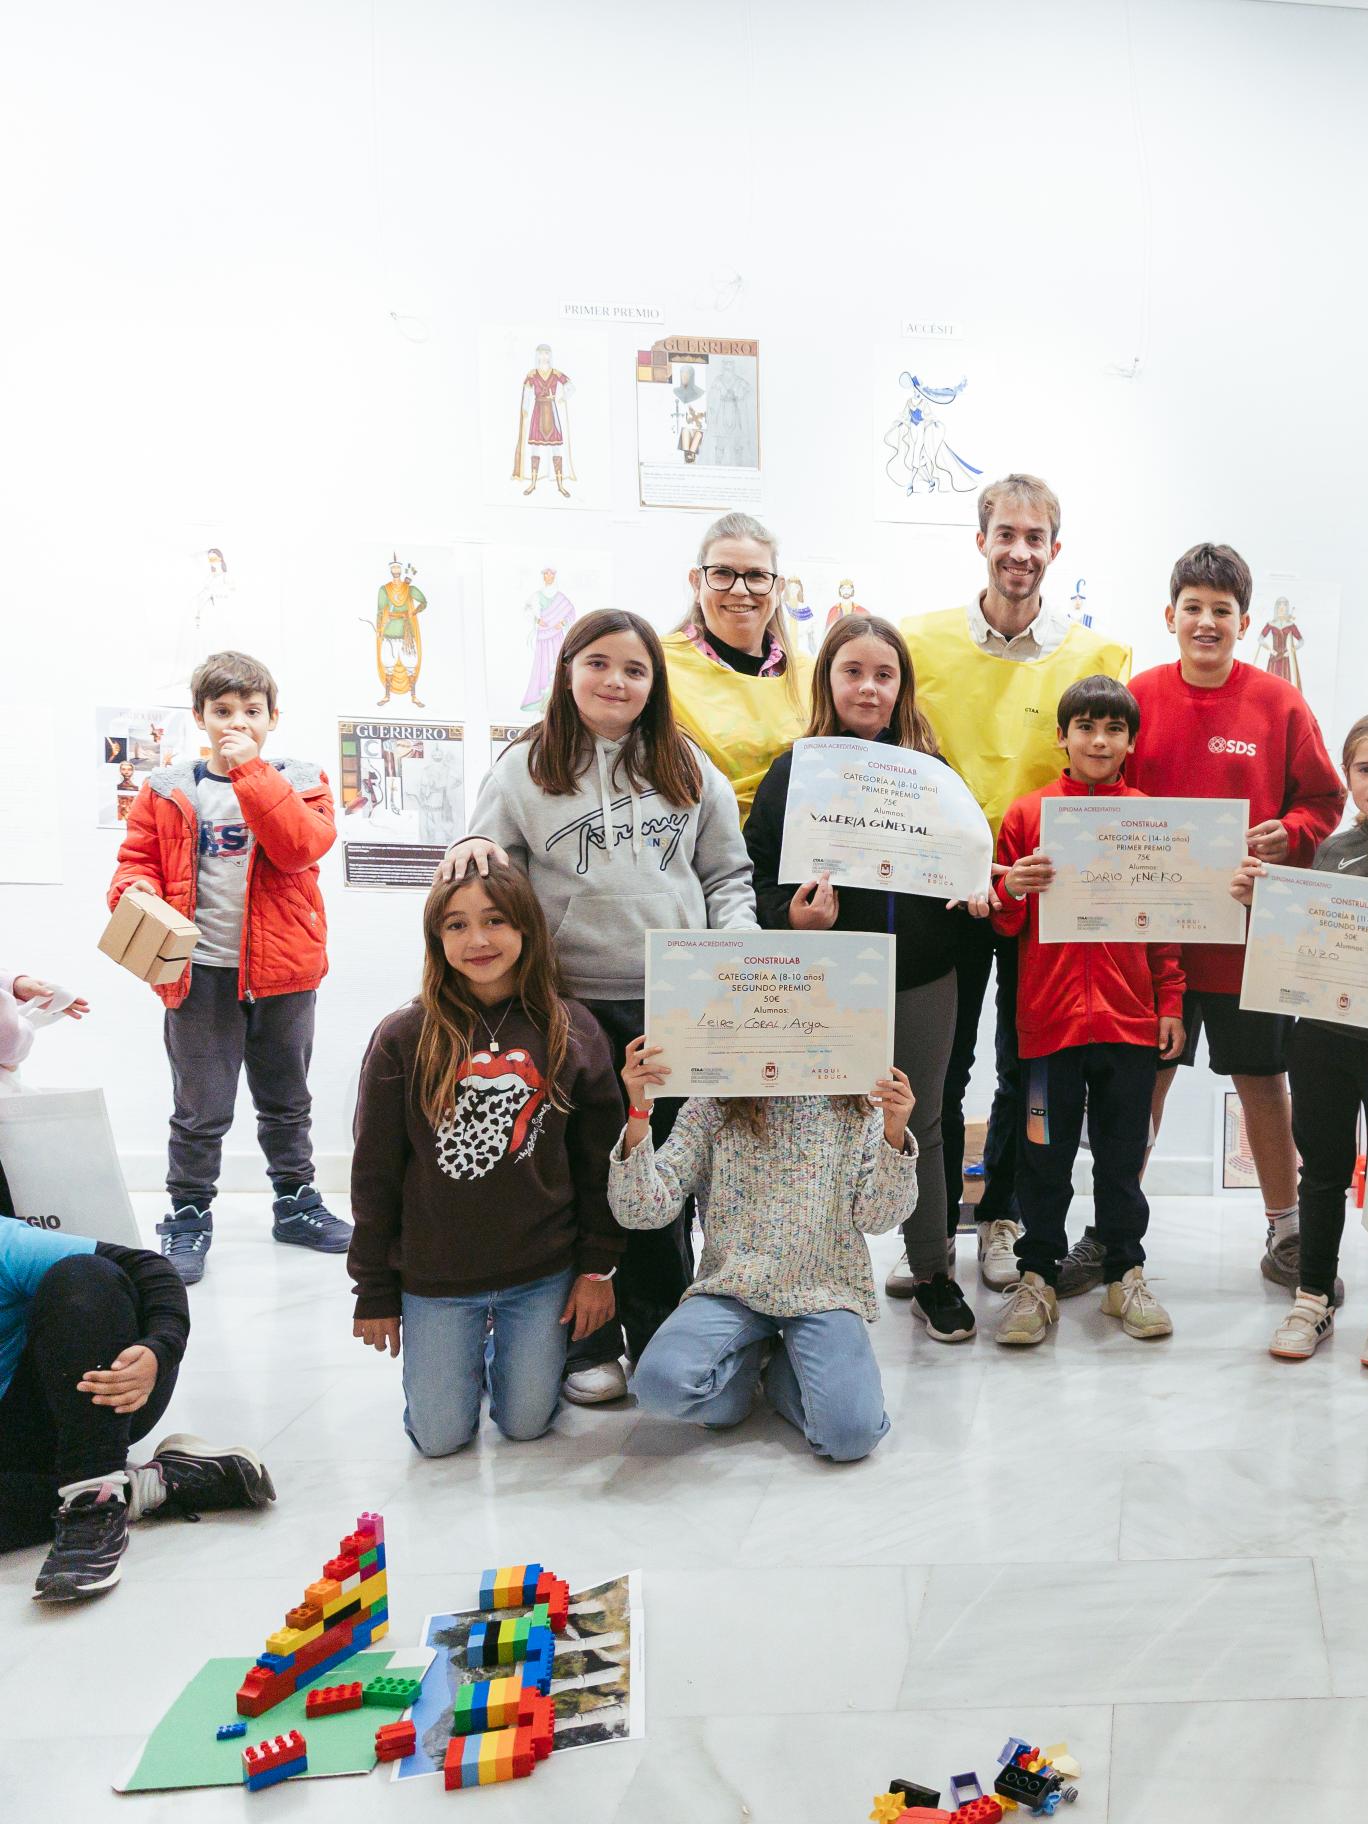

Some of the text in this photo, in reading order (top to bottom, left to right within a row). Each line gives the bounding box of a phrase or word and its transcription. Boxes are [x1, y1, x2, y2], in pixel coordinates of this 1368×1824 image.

[565, 304, 659, 319] PRIMER PREMIO
[663, 339, 753, 354] GUERRERO
[356, 725, 446, 740] GUERRERO
[1226, 739, 1256, 756] SDS
[868, 761, 917, 775] CONSTRULAB
[843, 772, 889, 786] CATEGORÍA
[862, 786, 920, 800] PRIMER PREMIO
[810, 812, 932, 836] VALERIA GINESTAL
[1081, 871, 1122, 884] DARIO
[1308, 908, 1349, 920] CATEGORÍA
[1320, 920, 1355, 931] SEGUNDO
[744, 956, 800, 964] CONSTRULAB
[718, 971, 769, 981] CATEGORÍA
[780, 973, 801, 982] (8-10
[803, 973, 824, 981] años)
[789, 1018, 829, 1034] Arya
